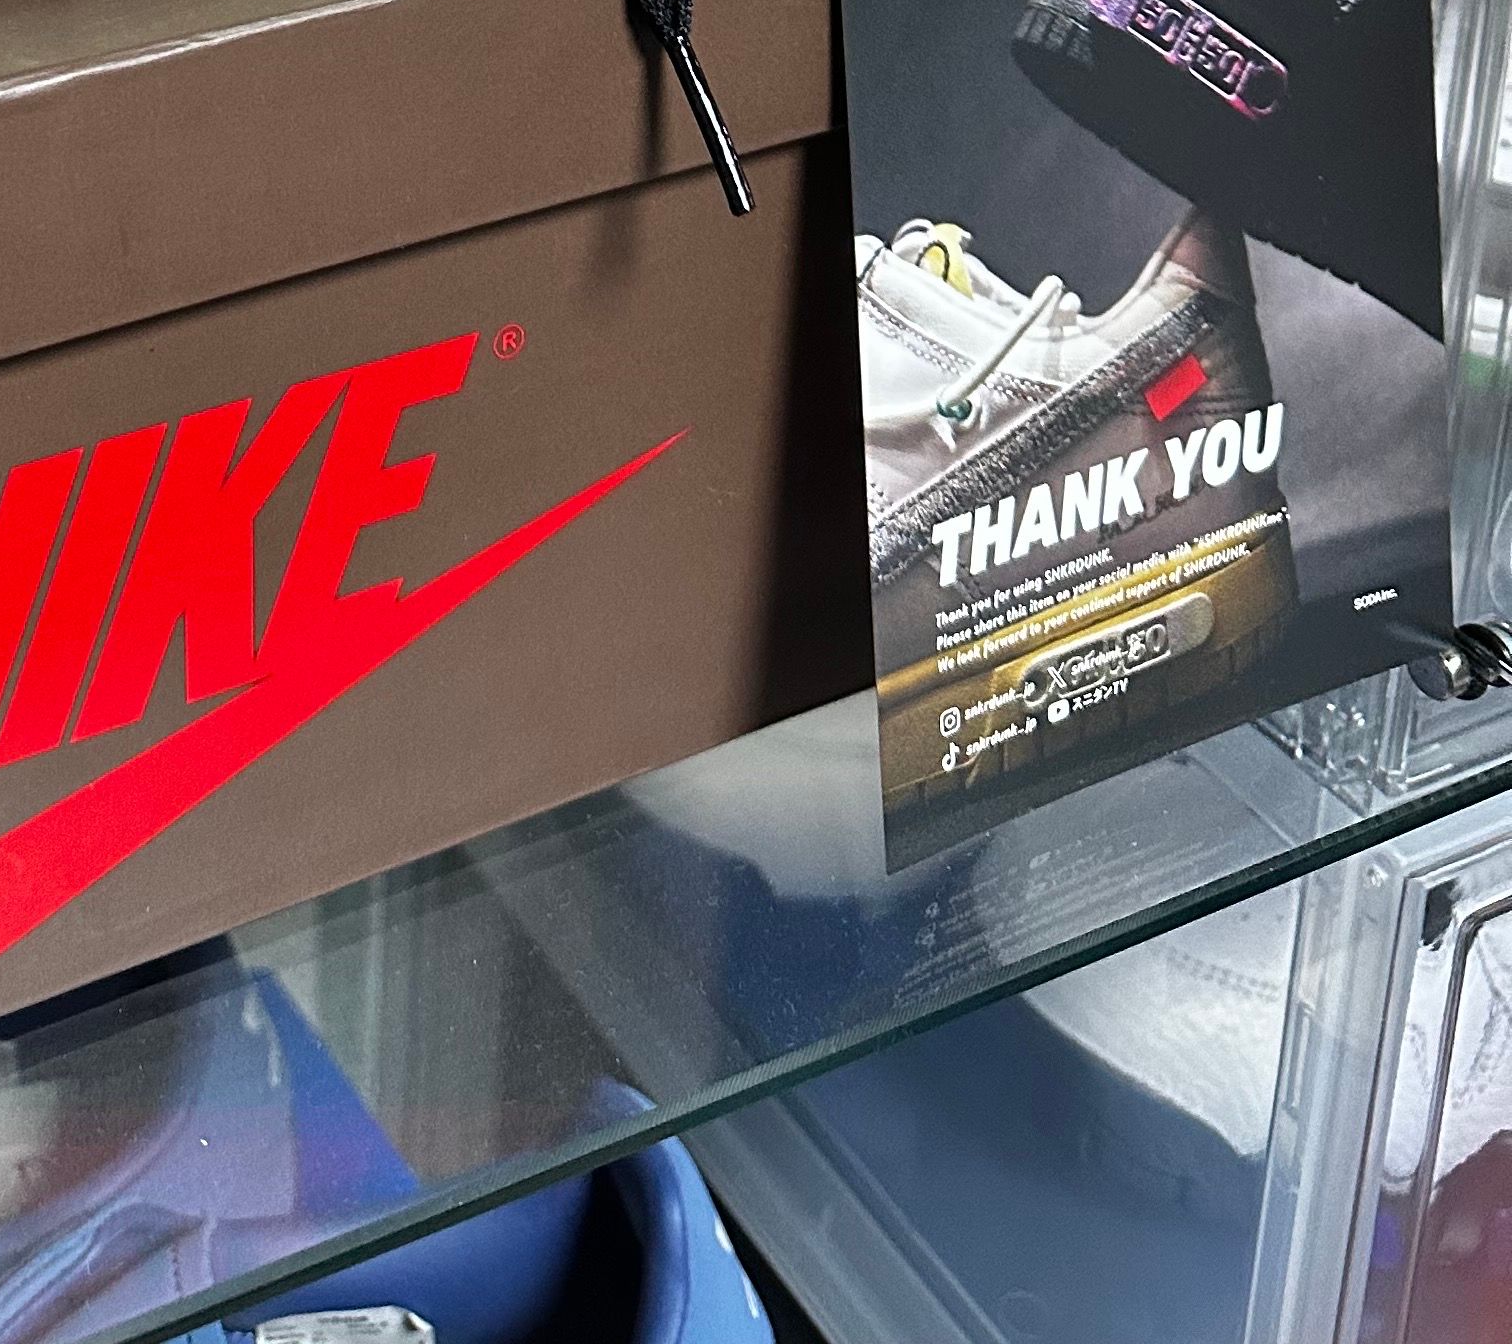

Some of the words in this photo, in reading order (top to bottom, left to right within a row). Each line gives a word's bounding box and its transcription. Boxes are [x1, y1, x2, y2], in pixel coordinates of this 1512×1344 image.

[931, 447, 1149, 588] THANK
[1164, 402, 1284, 500] YOU
[935, 602, 969, 629] Thank
[971, 596, 992, 617] you
[993, 588, 1011, 609] for
[1012, 576, 1044, 598] using
[936, 628, 973, 651] Please
[973, 613, 1005, 636] share
[1006, 603, 1028, 622] this
[1029, 595, 1055, 613] item
[1056, 587, 1071, 602] on
[1072, 578, 1098, 601] your
[1098, 562, 1131, 585] social
[1132, 552, 1166, 573] media
[1167, 541, 1193, 561] with
[937, 652, 955, 673] We
[957, 643, 982, 666] look
[983, 629, 1028, 659] forward
[1029, 622, 1042, 636] to
[1043, 611, 1069, 634] your
[1070, 587, 1124, 620] continued
[1125, 572, 1167, 599] support
[1168, 565, 1182, 584] of
